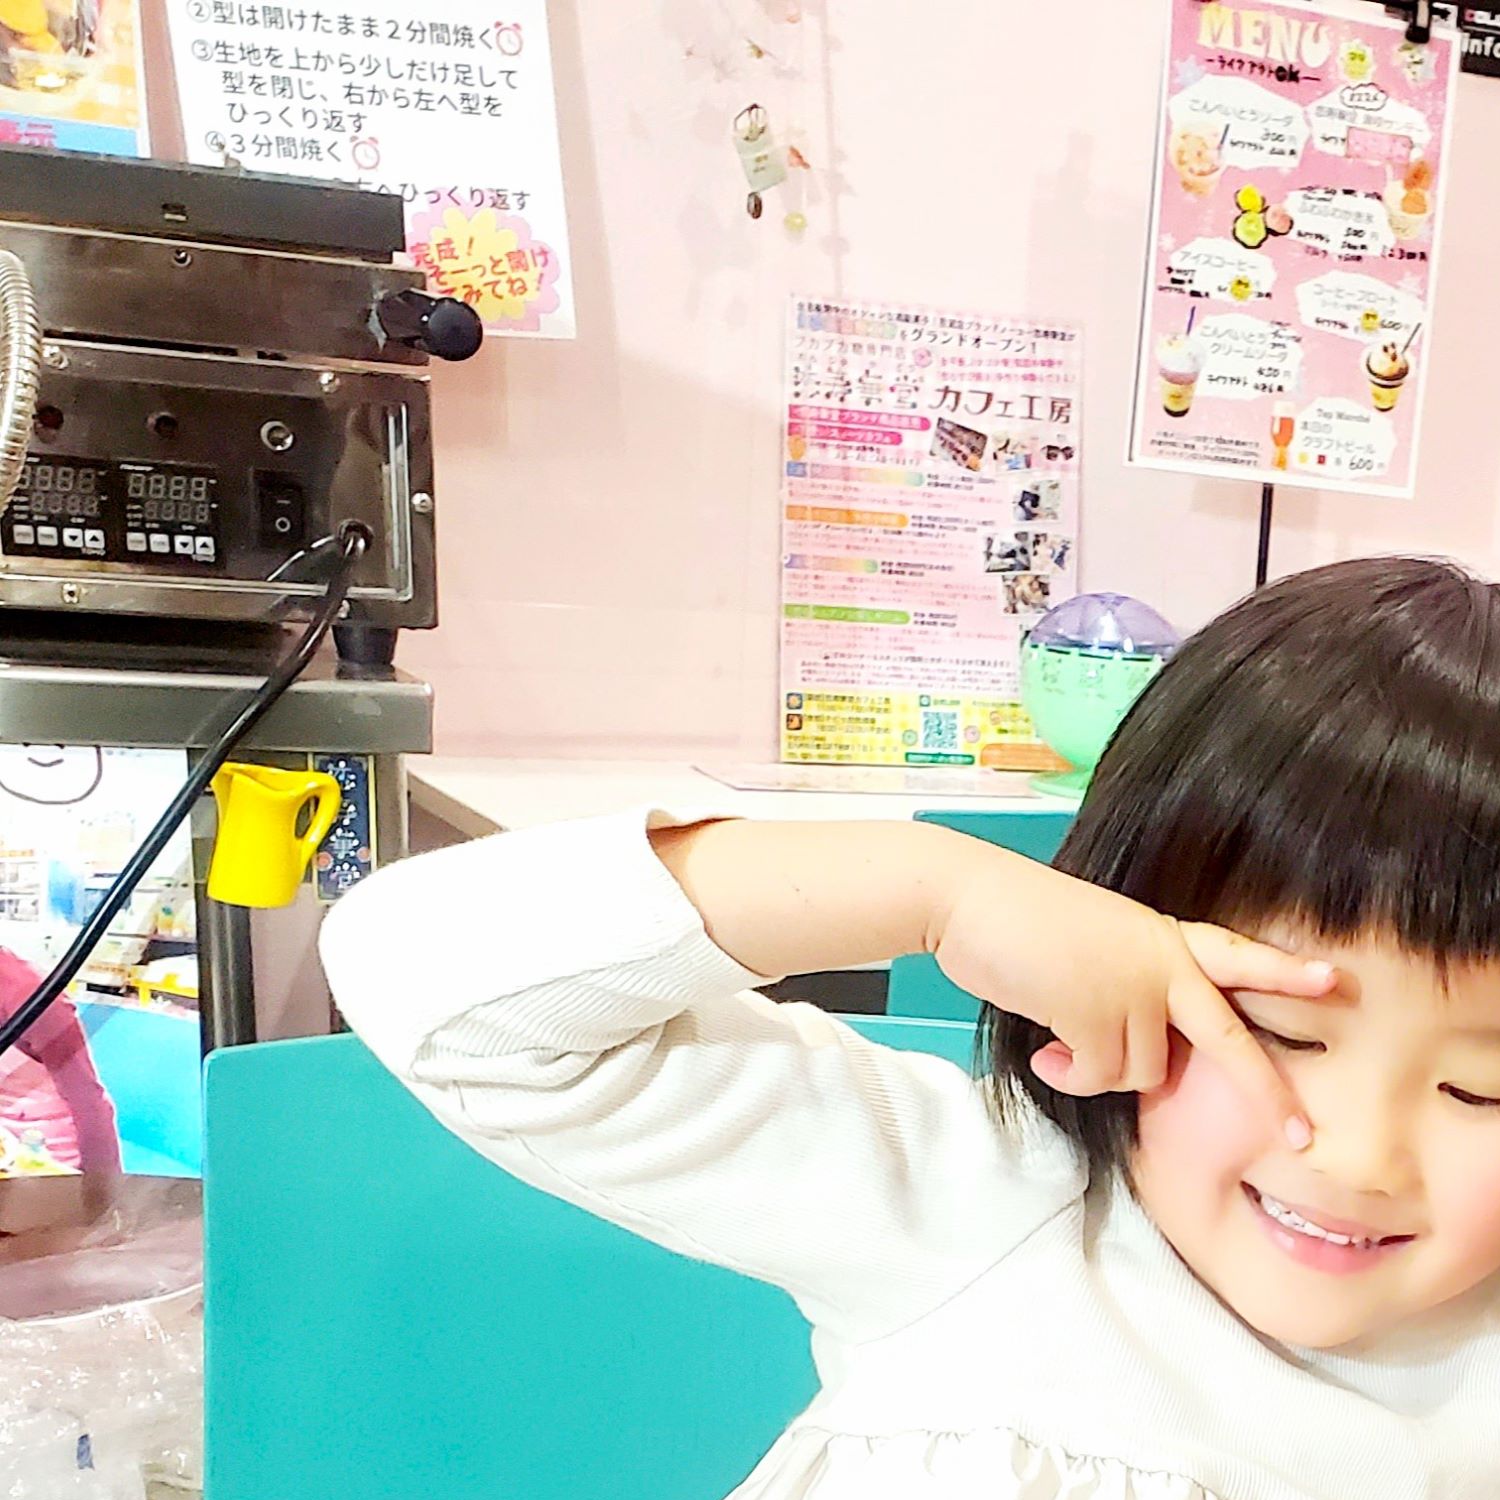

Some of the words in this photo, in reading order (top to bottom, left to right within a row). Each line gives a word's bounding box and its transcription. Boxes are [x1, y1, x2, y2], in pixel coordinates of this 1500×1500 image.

[1197, 2, 1332, 69] MENU
[222, 70, 502, 117] 型を閉じ、右から左へ型を
[227, 103, 367, 132] ひっくり返す
[928, 385, 1073, 424] カフェ工房
